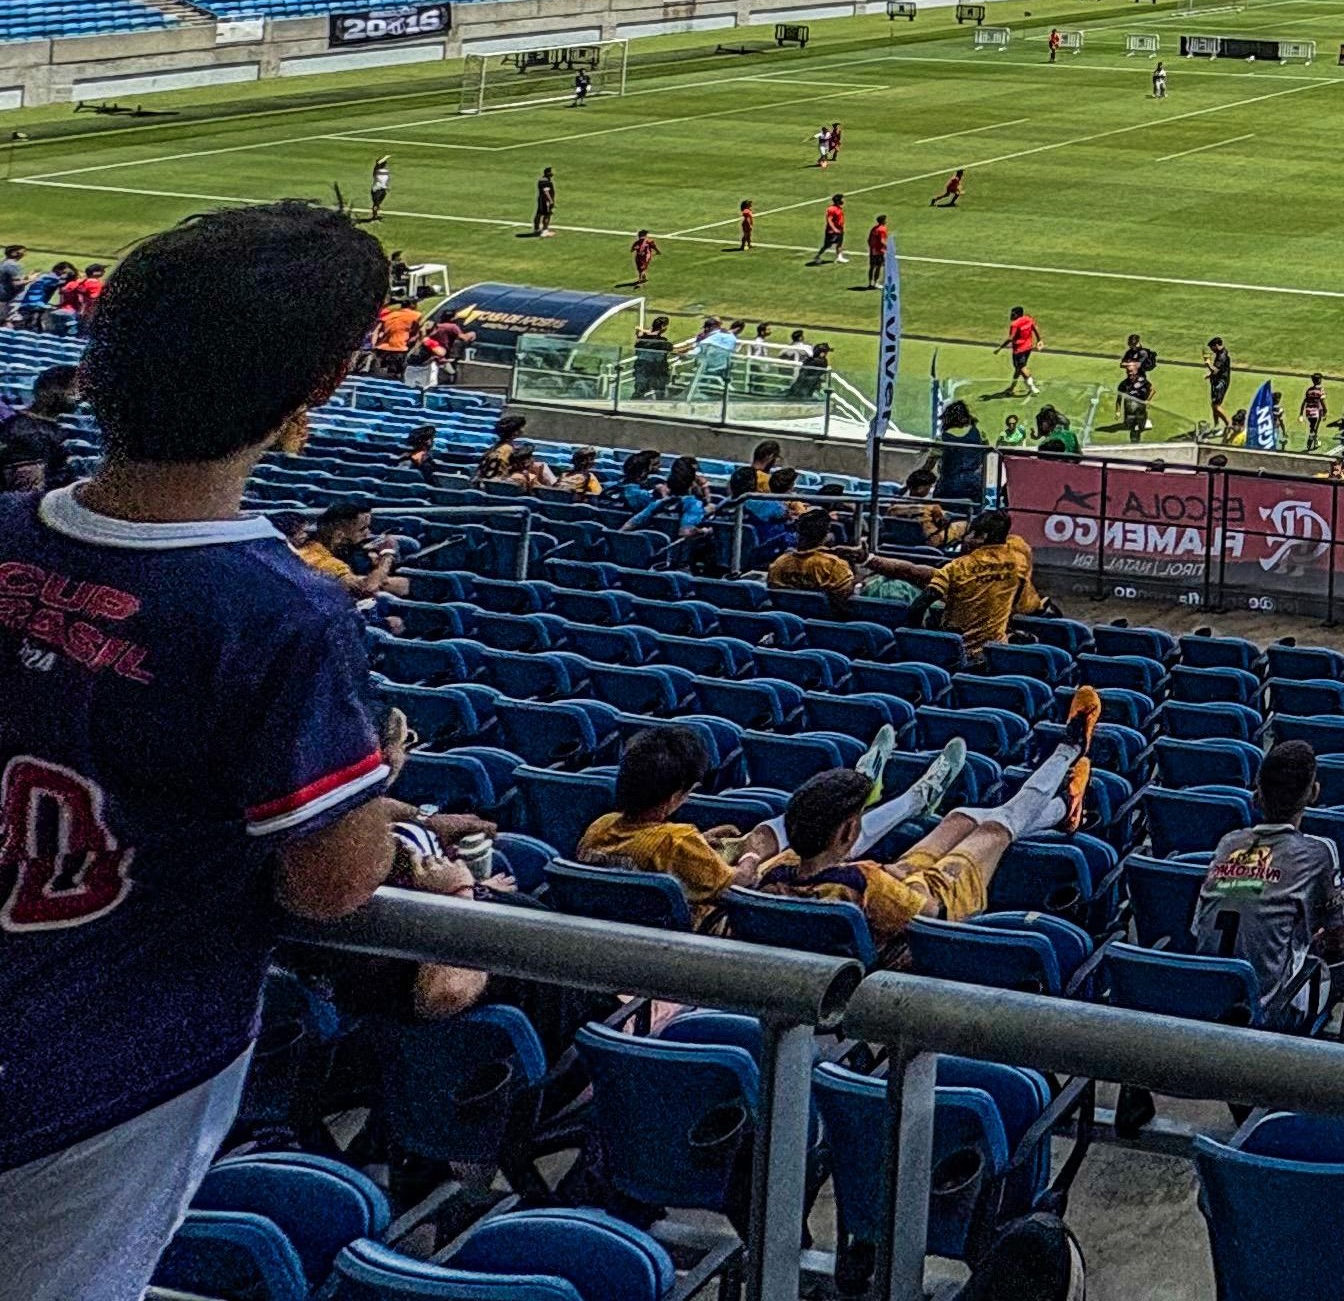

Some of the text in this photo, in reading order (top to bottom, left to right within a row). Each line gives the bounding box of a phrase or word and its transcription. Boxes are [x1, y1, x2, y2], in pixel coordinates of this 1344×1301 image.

[882, 316, 896, 422] viver
[1248, 865, 1282, 883] SILVA
[1214, 909, 1241, 958] 1
